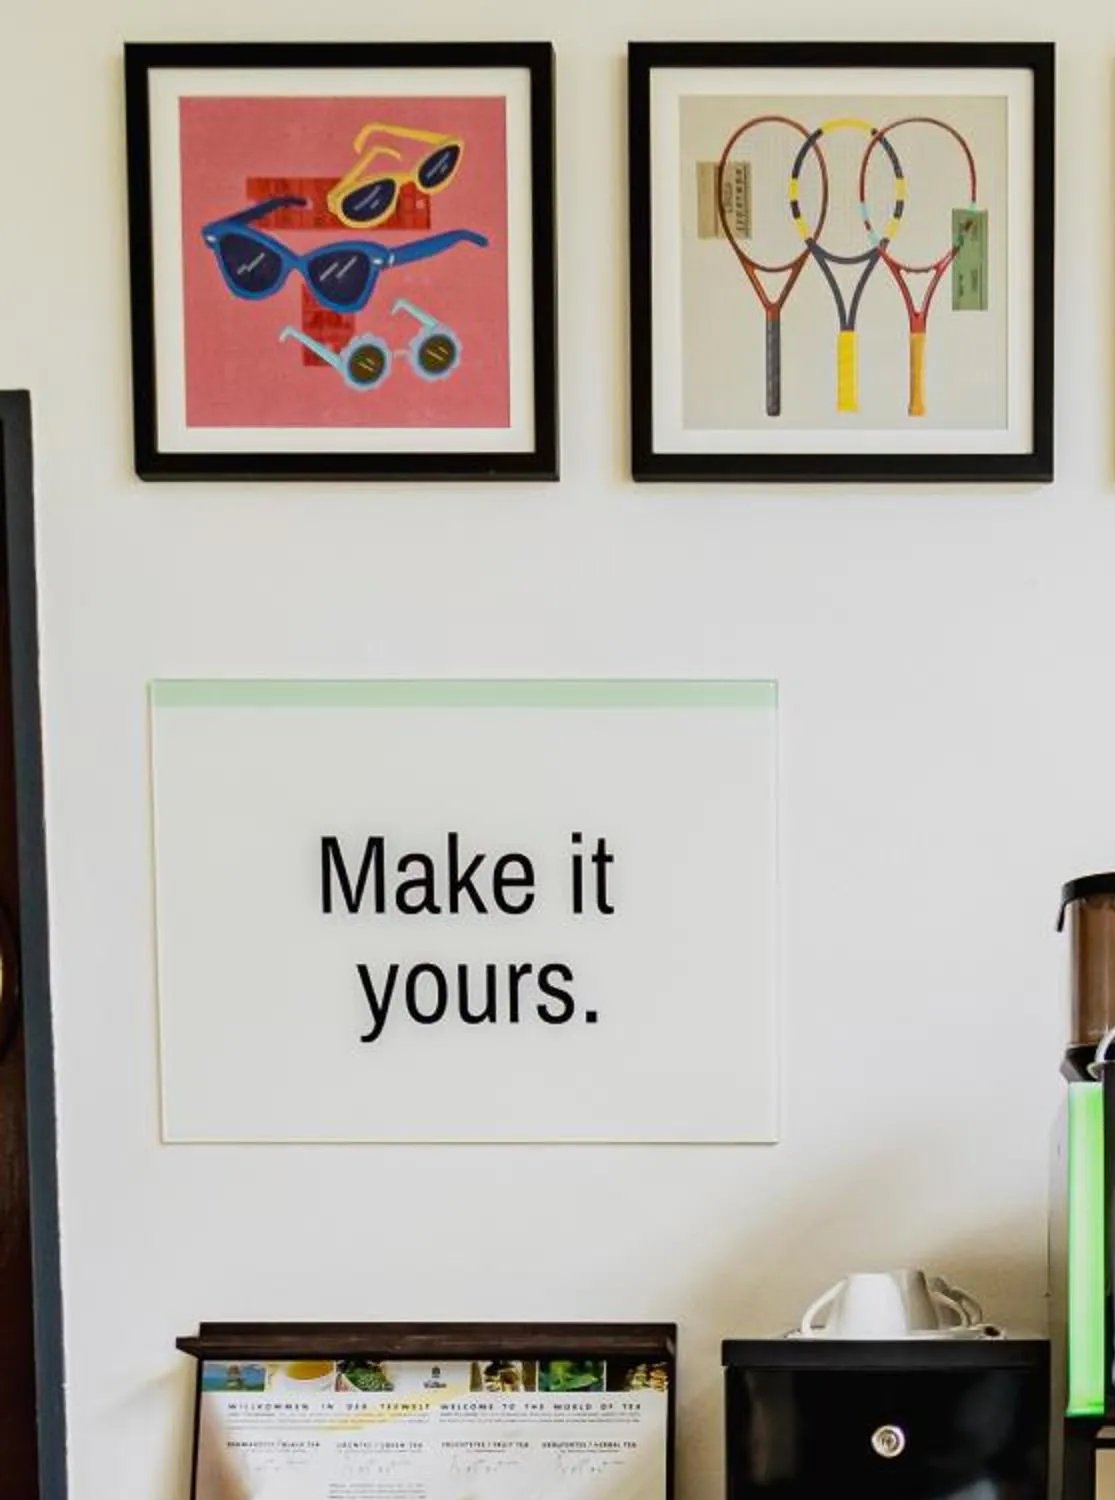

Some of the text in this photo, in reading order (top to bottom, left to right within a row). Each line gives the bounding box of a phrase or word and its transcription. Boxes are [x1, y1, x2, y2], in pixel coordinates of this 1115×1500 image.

[322, 832, 614, 914] Make it
[357, 963, 597, 1042] yours.
